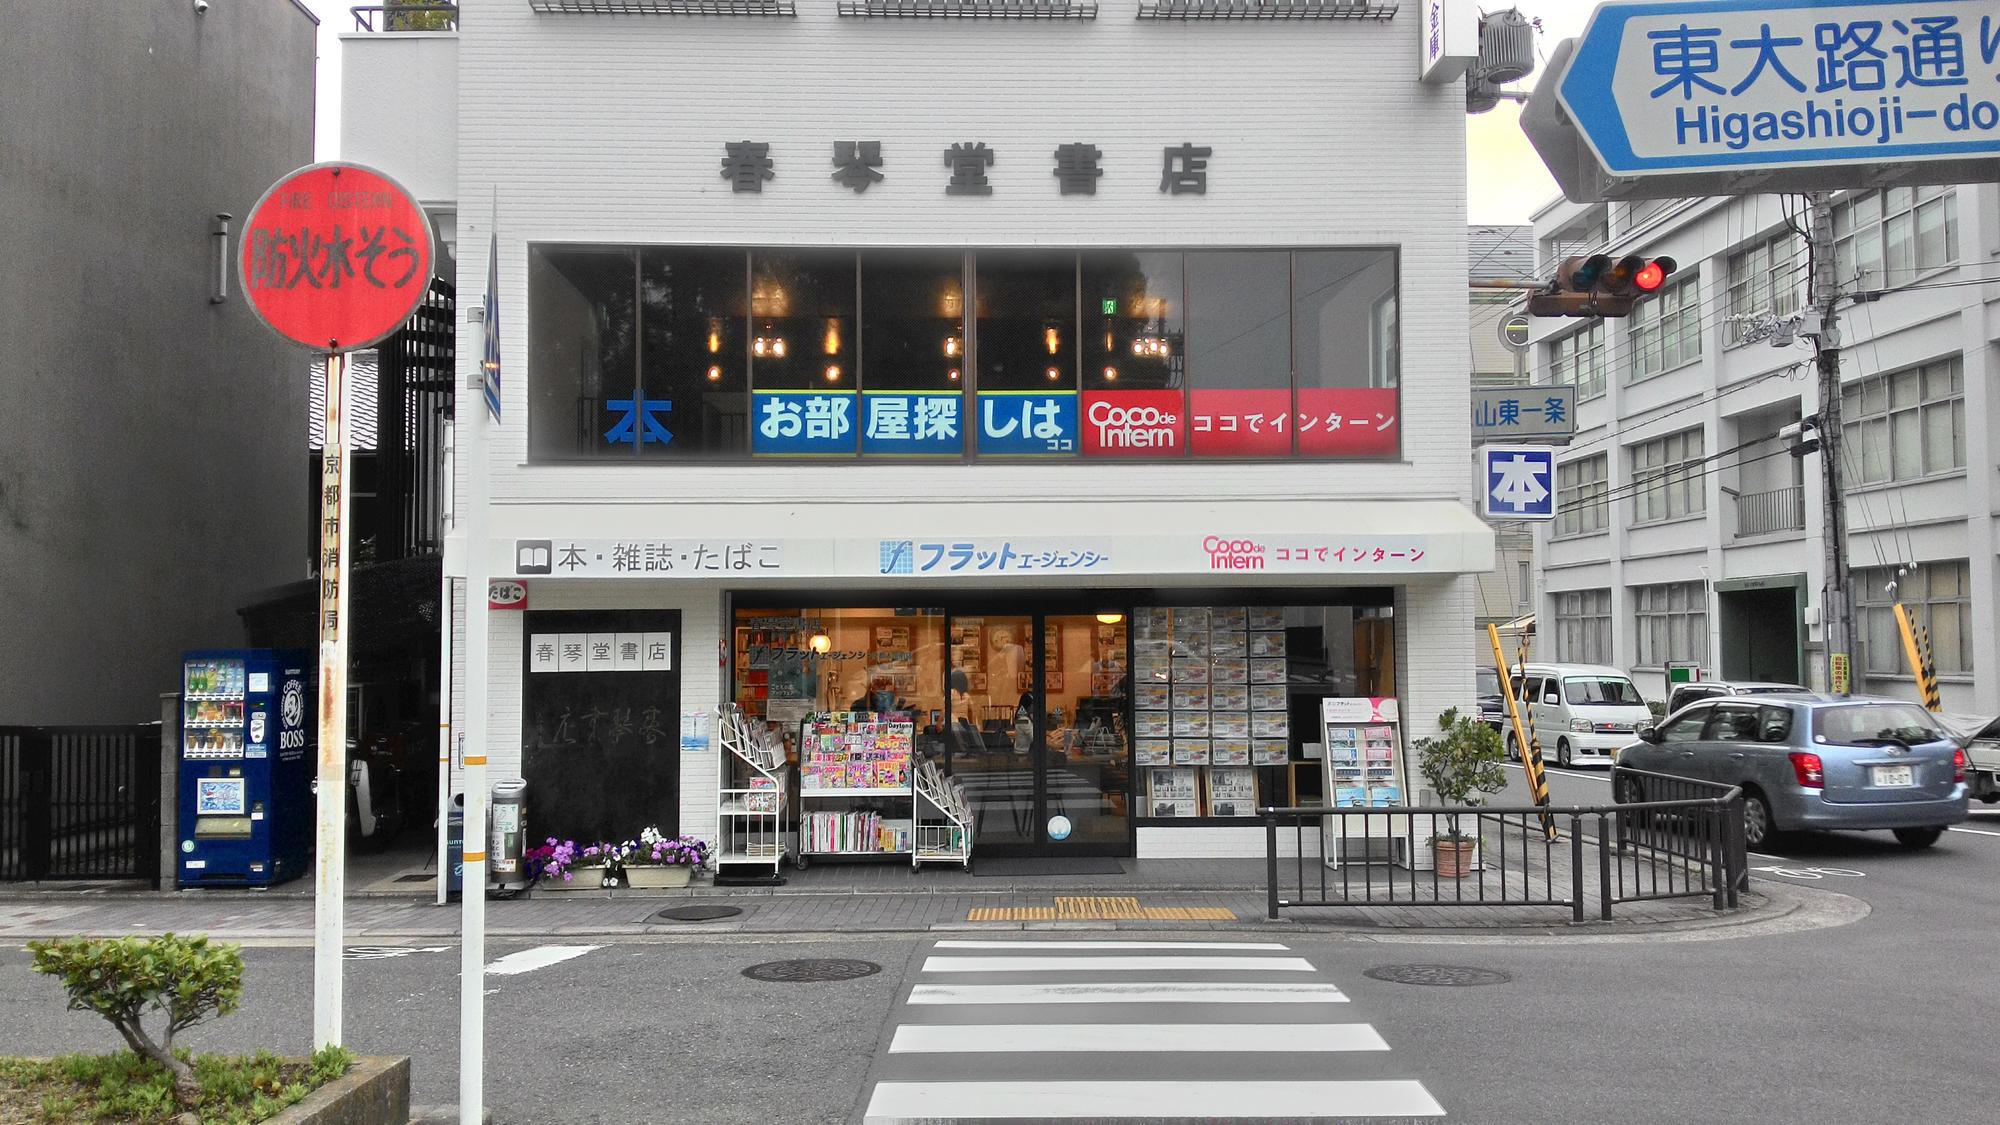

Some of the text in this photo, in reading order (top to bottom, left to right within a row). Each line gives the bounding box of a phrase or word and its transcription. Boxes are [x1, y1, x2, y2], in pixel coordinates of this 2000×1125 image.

[719, 140, 1213, 195] 春琴堂書店
[251, 225, 419, 289] 防火水そう
[603, 388, 674, 455] 本
[760, 396, 1064, 440] お部屋探しは
[1193, 412, 1395, 433] ココでインターン
[1471, 397, 1565, 427] 山東一条
[1099, 423, 1174, 447] Intern
[1490, 454, 1549, 512] 本
[322, 453, 340, 631] 京都市消防局
[1276, 547, 1425, 562] ココでインターン
[558, 543, 781, 572] 本・雑誌・たばこ
[1209, 552, 1264, 569] Intern
[489, 585, 522, 600] たばこ
[535, 642, 667, 663] 春琴堂書店
[280, 730, 304, 749] BOSS
